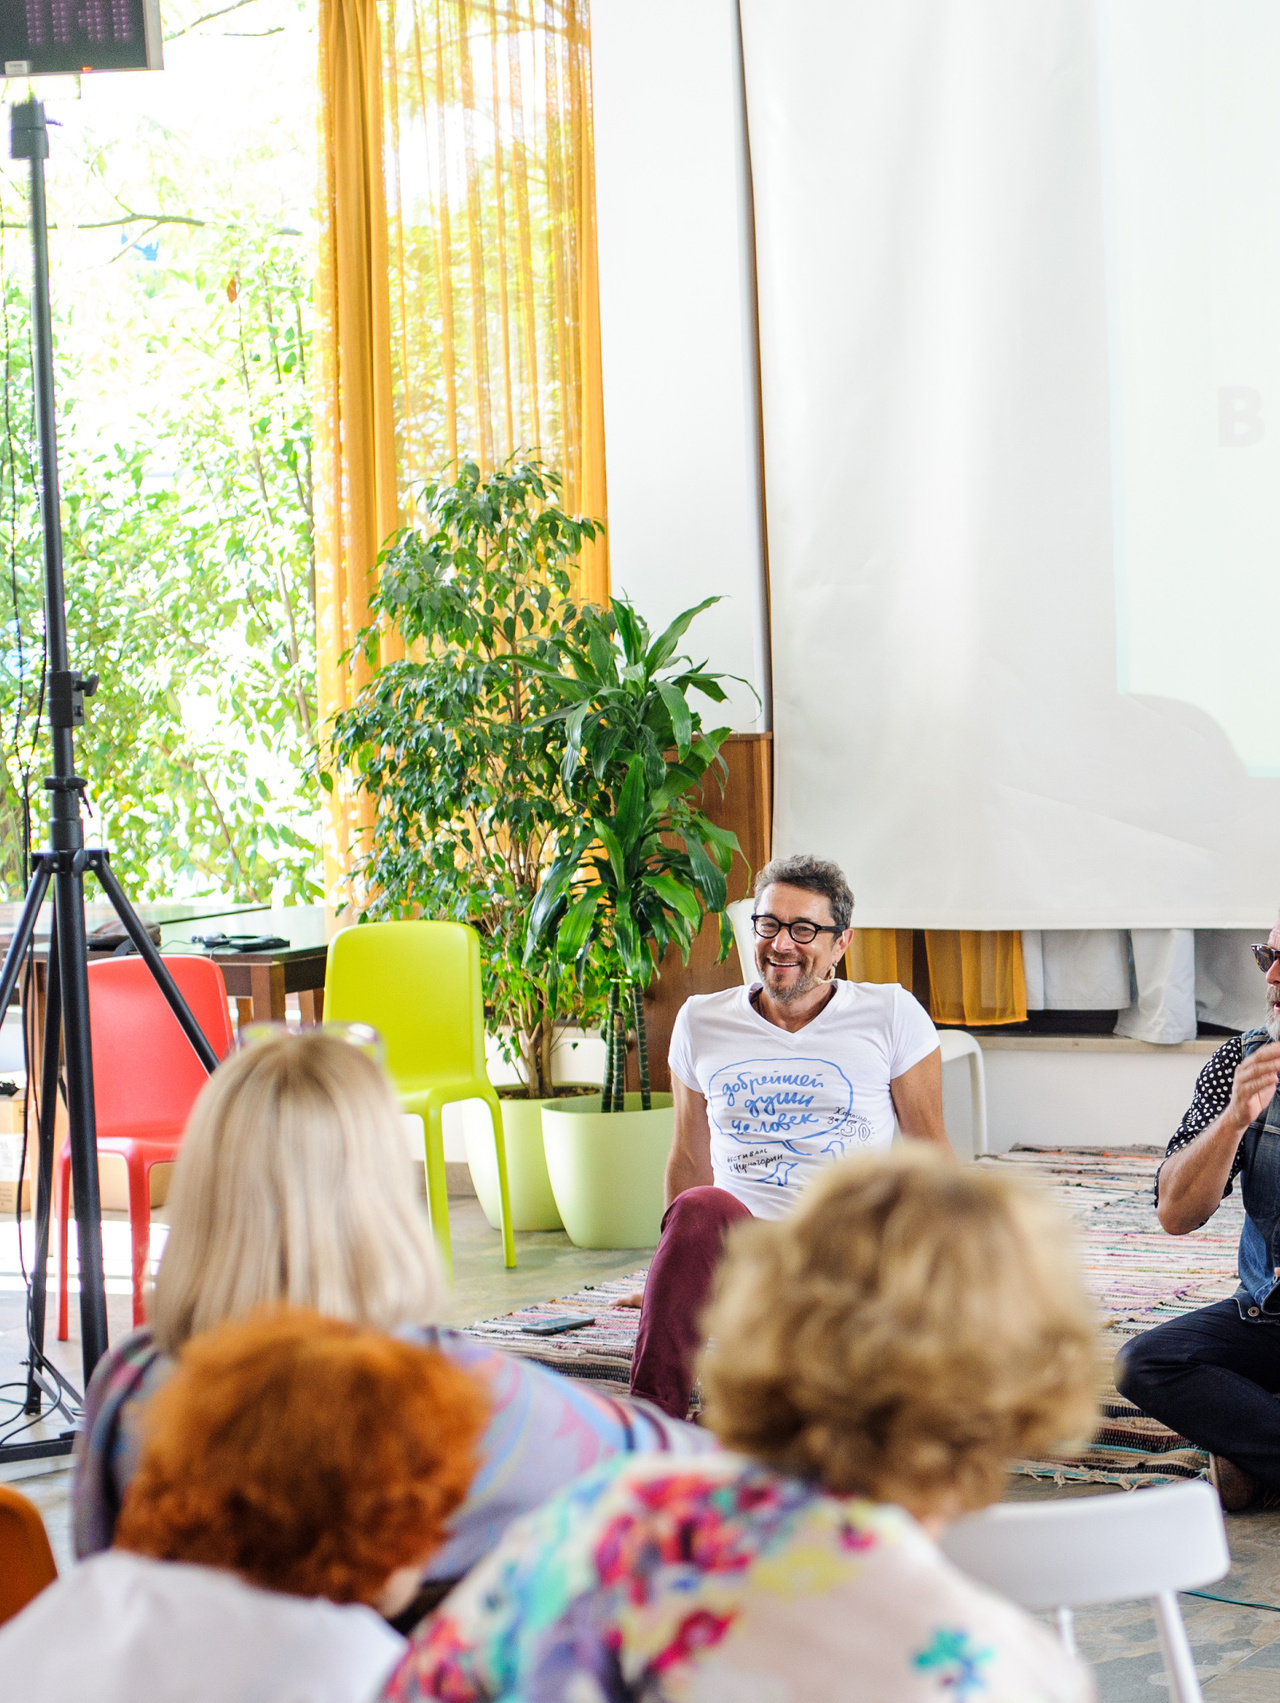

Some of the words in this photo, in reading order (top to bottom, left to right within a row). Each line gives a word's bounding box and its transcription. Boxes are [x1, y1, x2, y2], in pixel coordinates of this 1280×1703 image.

[722, 1070, 824, 1107] добрейшей
[744, 1092, 815, 1118] души
[731, 1112, 820, 1135] человек
